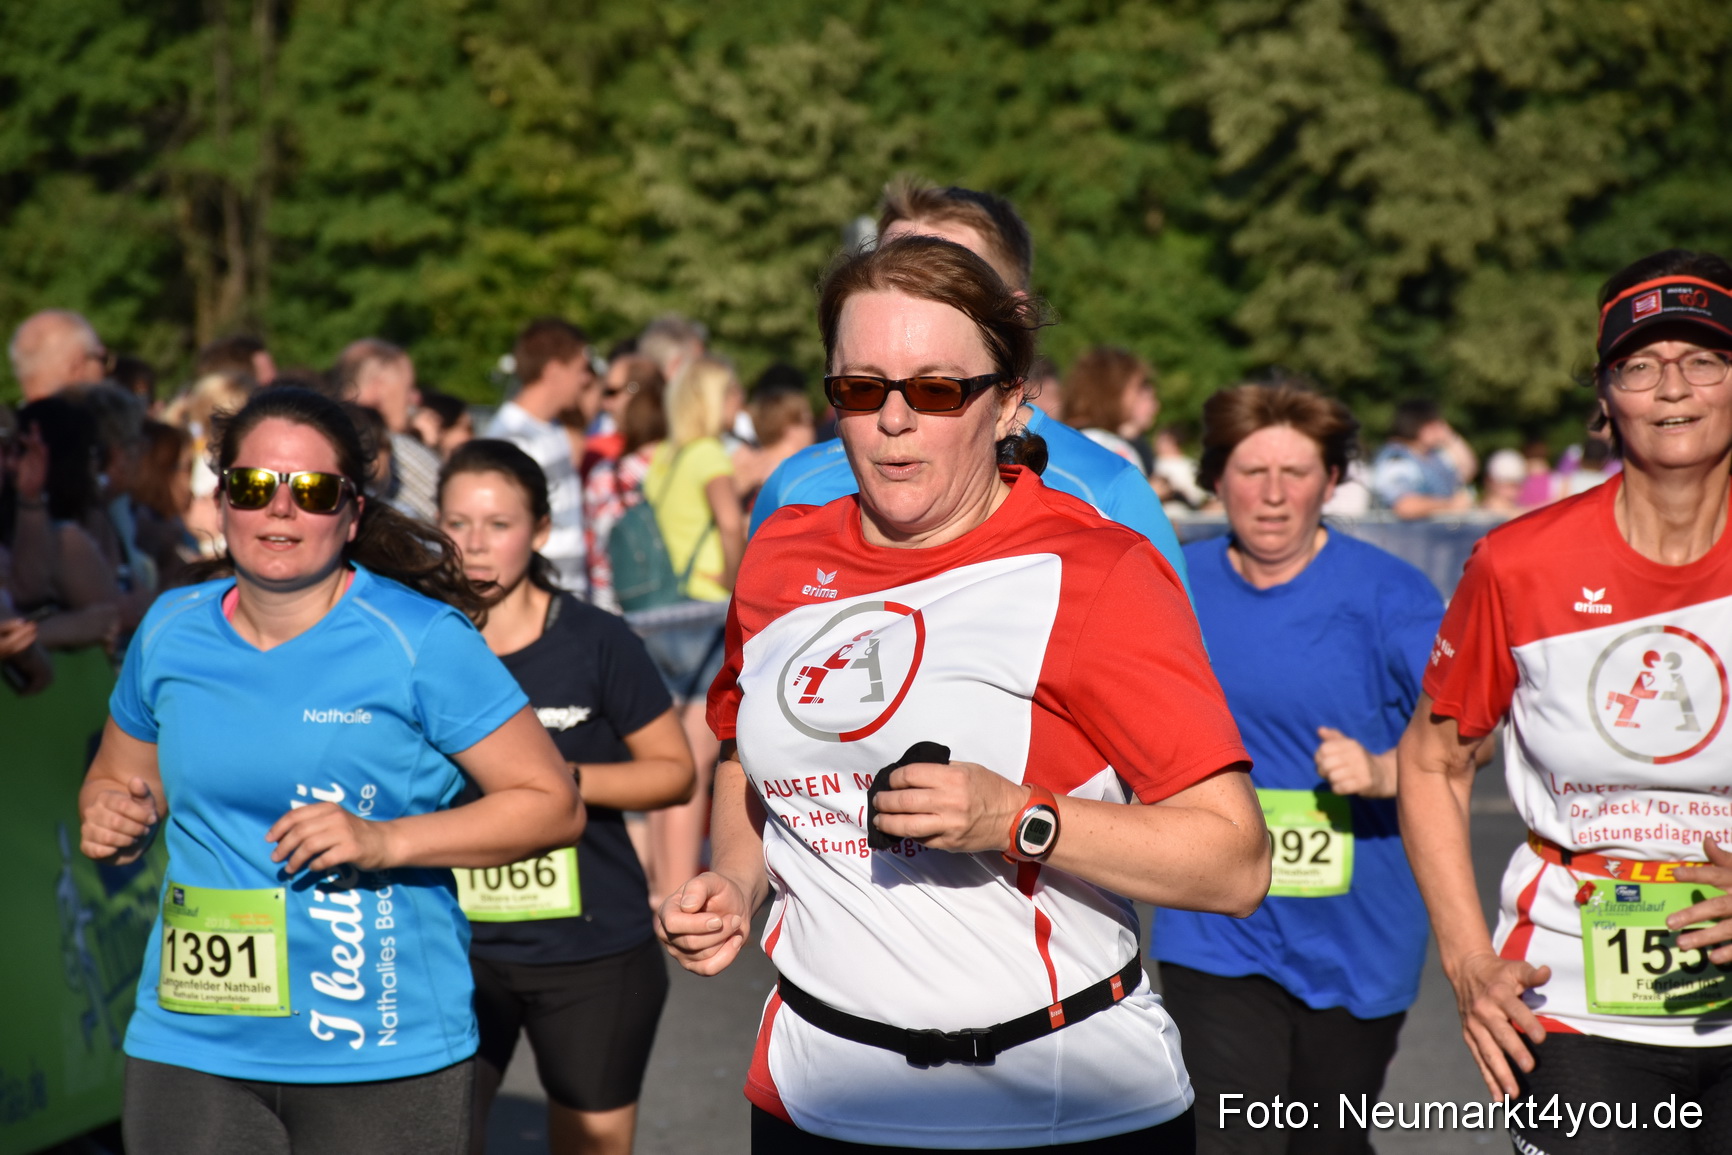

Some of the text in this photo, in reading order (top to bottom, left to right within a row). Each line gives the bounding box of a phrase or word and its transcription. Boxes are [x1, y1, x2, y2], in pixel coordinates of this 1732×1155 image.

[801, 584, 839, 599] erima
[1573, 600, 1613, 614] erima
[303, 708, 373, 725] Nathalie
[1570, 803, 1594, 819] Dr.
[1598, 800, 1641, 816] Heck
[1658, 801, 1684, 816] Dr.
[808, 809, 855, 828] Heck
[1604, 900, 1666, 913] firmenlauf
[166, 928, 257, 979] 1391
[223, 981, 272, 994] Nathalie
[374, 936, 399, 1048] Nathalies
[1632, 992, 1662, 1002] Praxis
